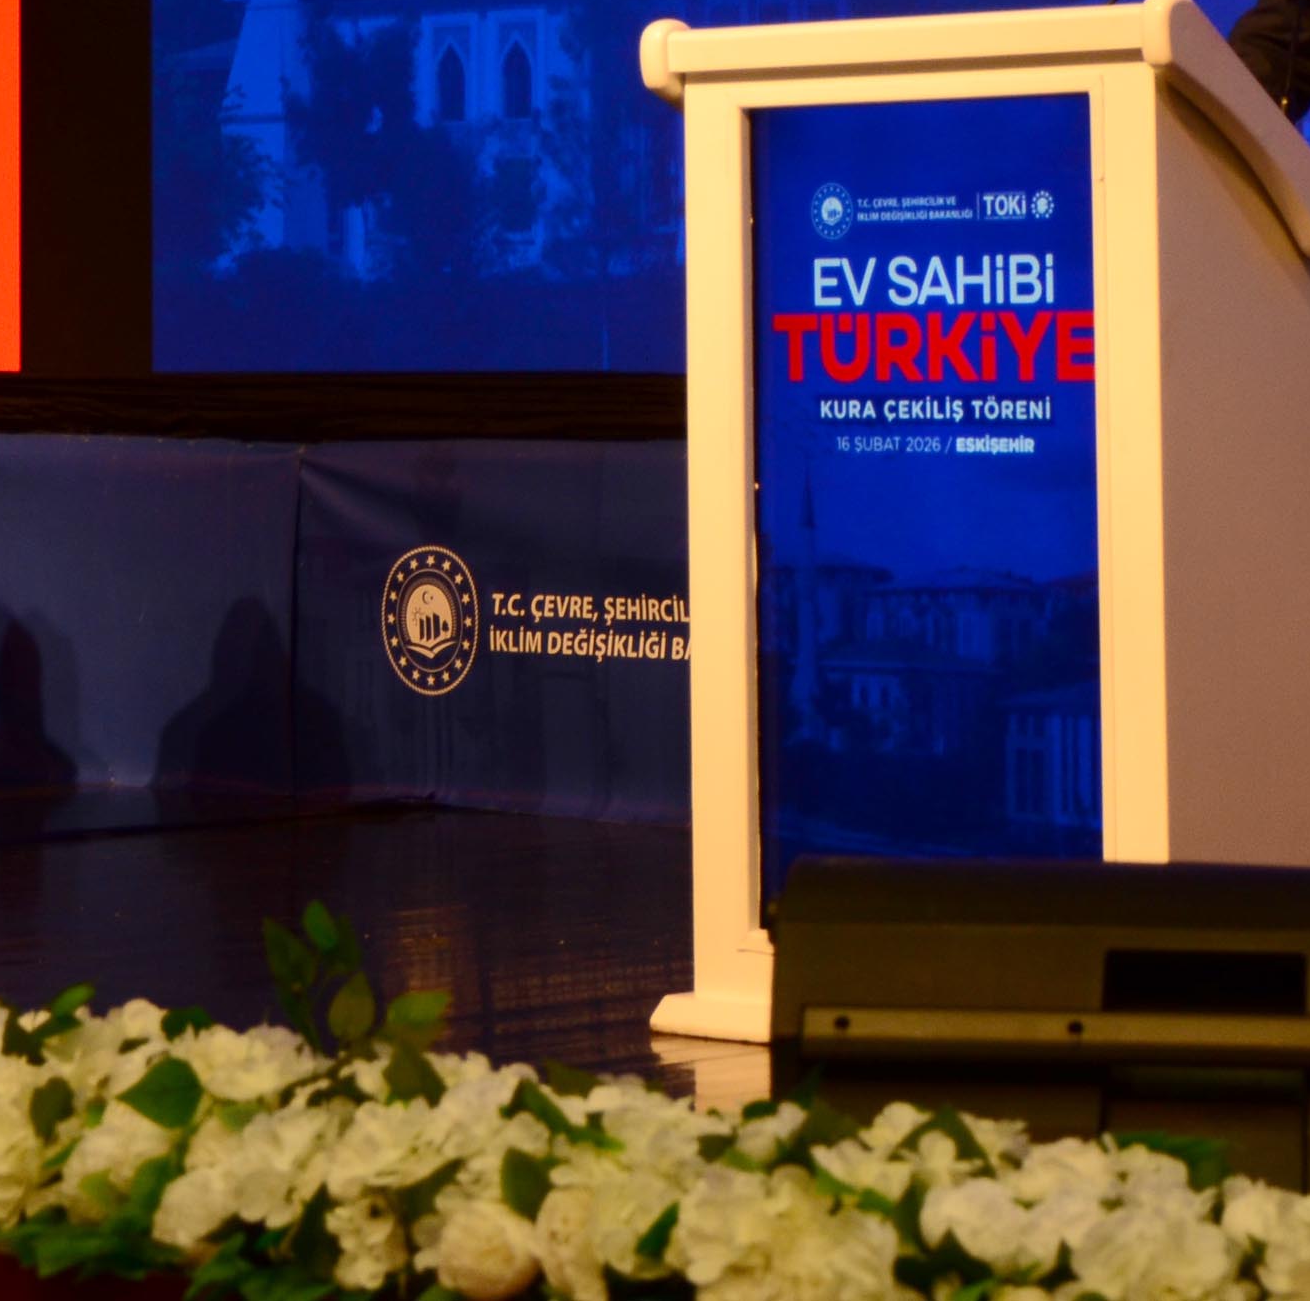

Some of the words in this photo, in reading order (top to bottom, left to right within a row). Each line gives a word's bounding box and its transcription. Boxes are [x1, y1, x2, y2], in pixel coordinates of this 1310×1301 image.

[813, 257, 877, 306] EV
[820, 399, 877, 420] KURA
[884, 396, 964, 423] ÇEKİLİŞ
[971, 395, 1052, 420] TÖRENİ
[836, 436, 850, 451] 16
[854, 435, 901, 454] ŞUBAT
[906, 436, 942, 451] 2026
[492, 593, 525, 617] T.C.
[531, 595, 599, 623] ÇEVRE,
[603, 593, 689, 626] ŞEHİRCİL
[490, 625, 542, 653] İKLİM
[547, 627, 666, 664] DEĞİŞİKLİĞİ
